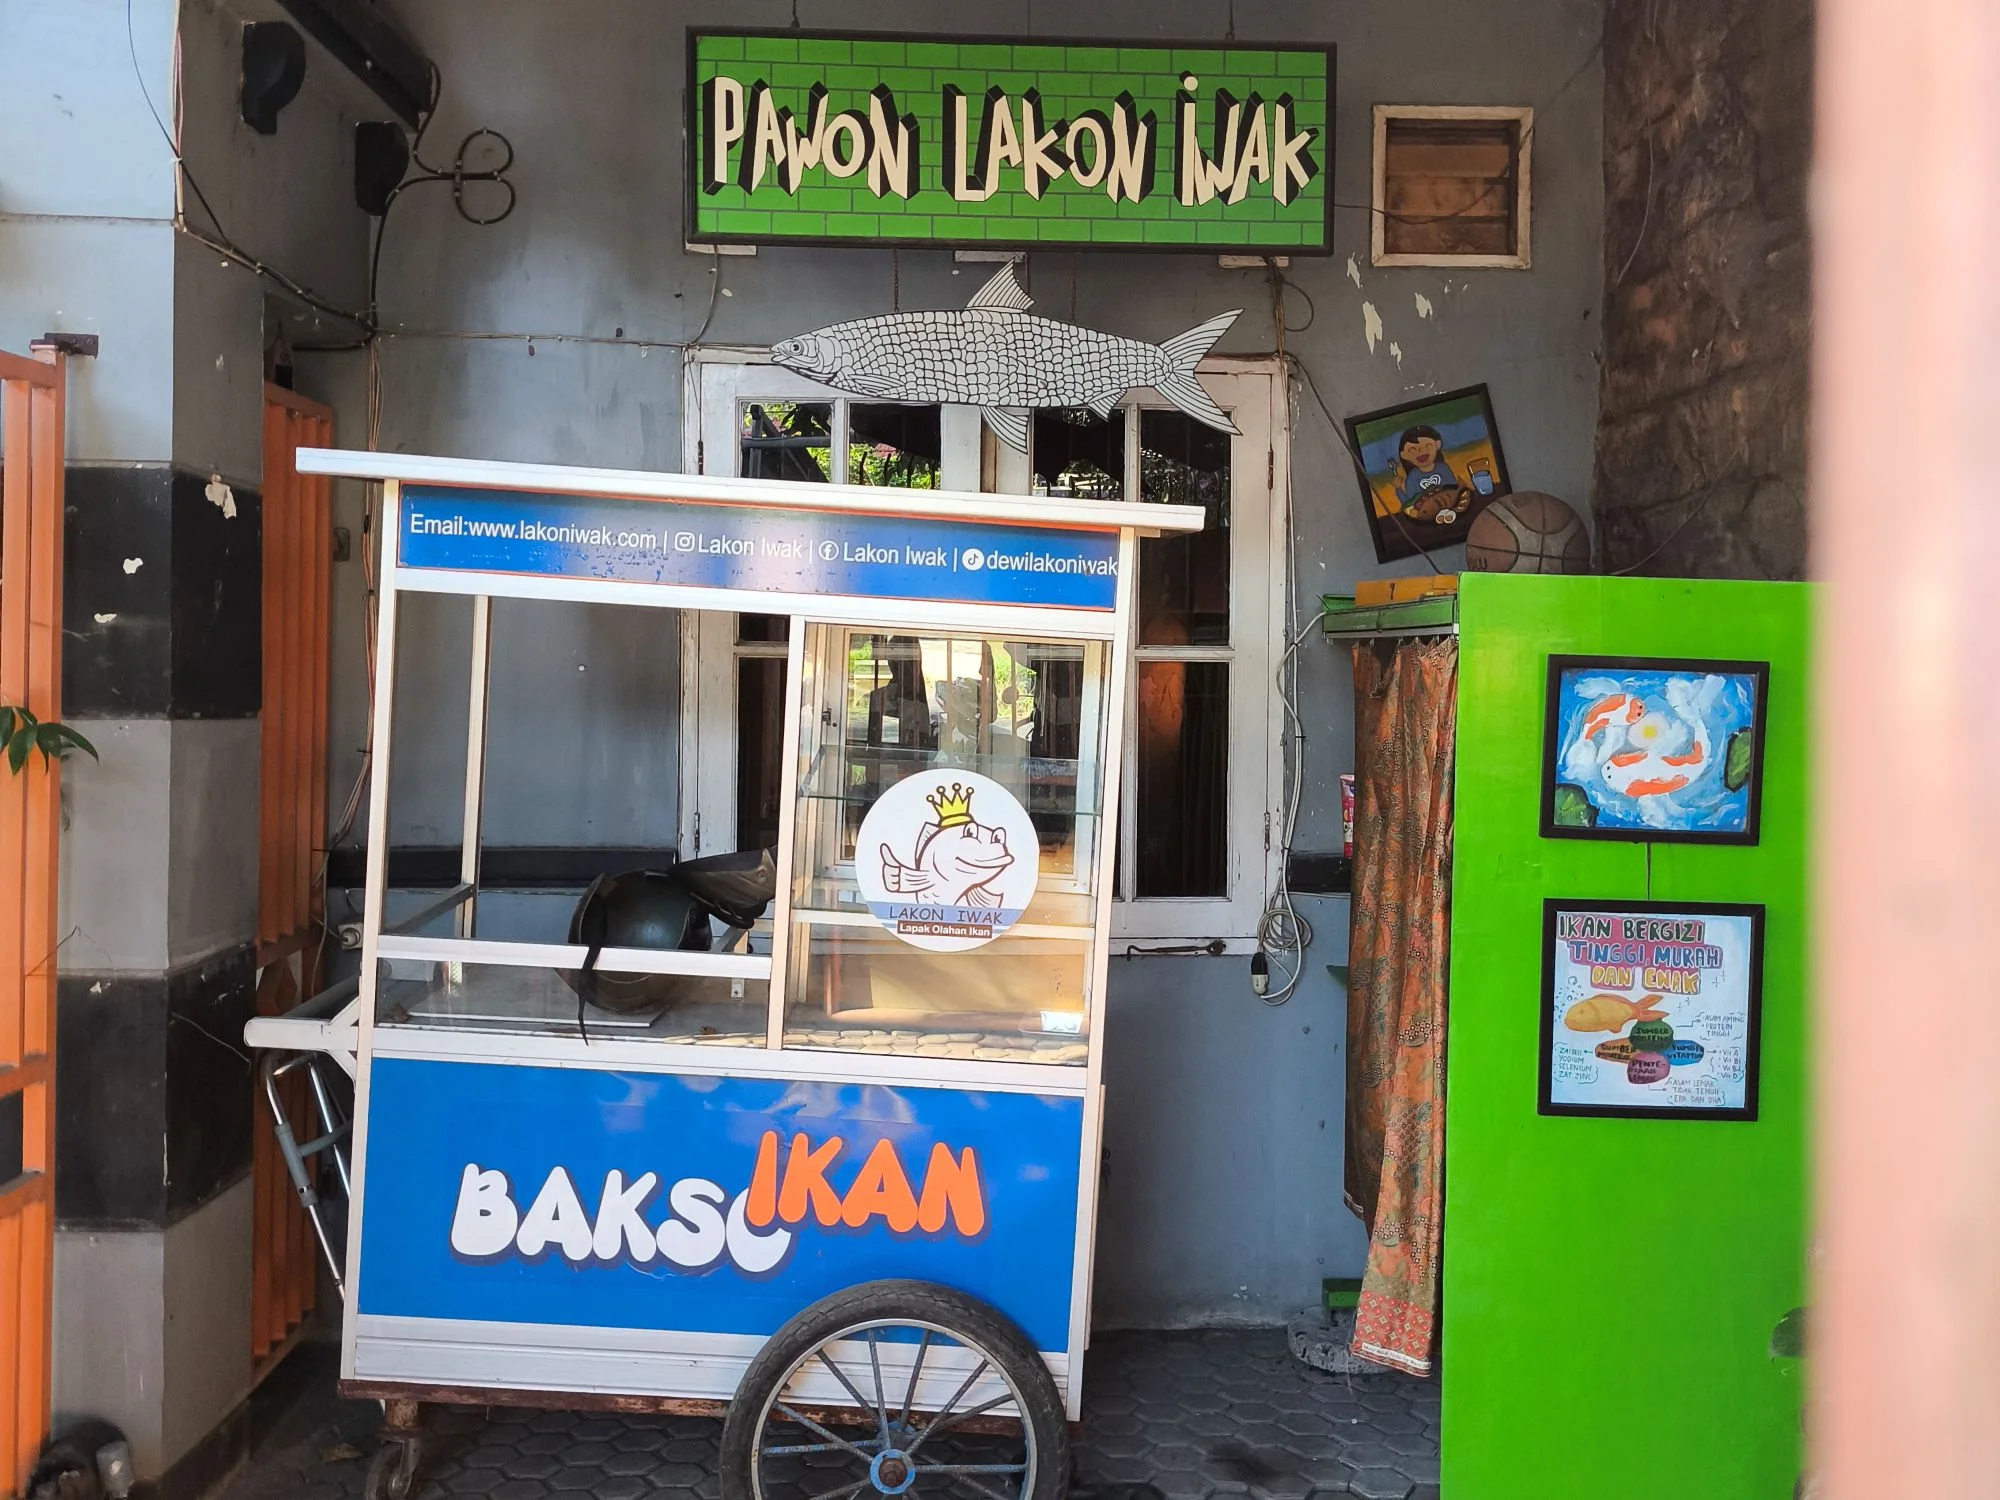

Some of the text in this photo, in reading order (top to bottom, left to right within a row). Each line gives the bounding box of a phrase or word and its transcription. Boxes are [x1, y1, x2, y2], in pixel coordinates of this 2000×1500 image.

[703, 75, 920, 199] PAWON
[699, 532, 754, 556] Lakon
[761, 539, 802, 559] Iwak
[843, 541, 899, 565] Lakon
[906, 545, 947, 567] Iwak
[986, 549, 1118, 576] dewilakoniwak
[889, 906, 1003, 924] LAKON IWAK
[1558, 914, 1705, 943] IKAN BERGIZI
[900, 923, 991, 937] Lapak Olahan Ikan
[1653, 944, 1722, 968] MURAH
[1591, 966, 1700, 994] DAN ENAK
[747, 1130, 985, 1236] IKAN
